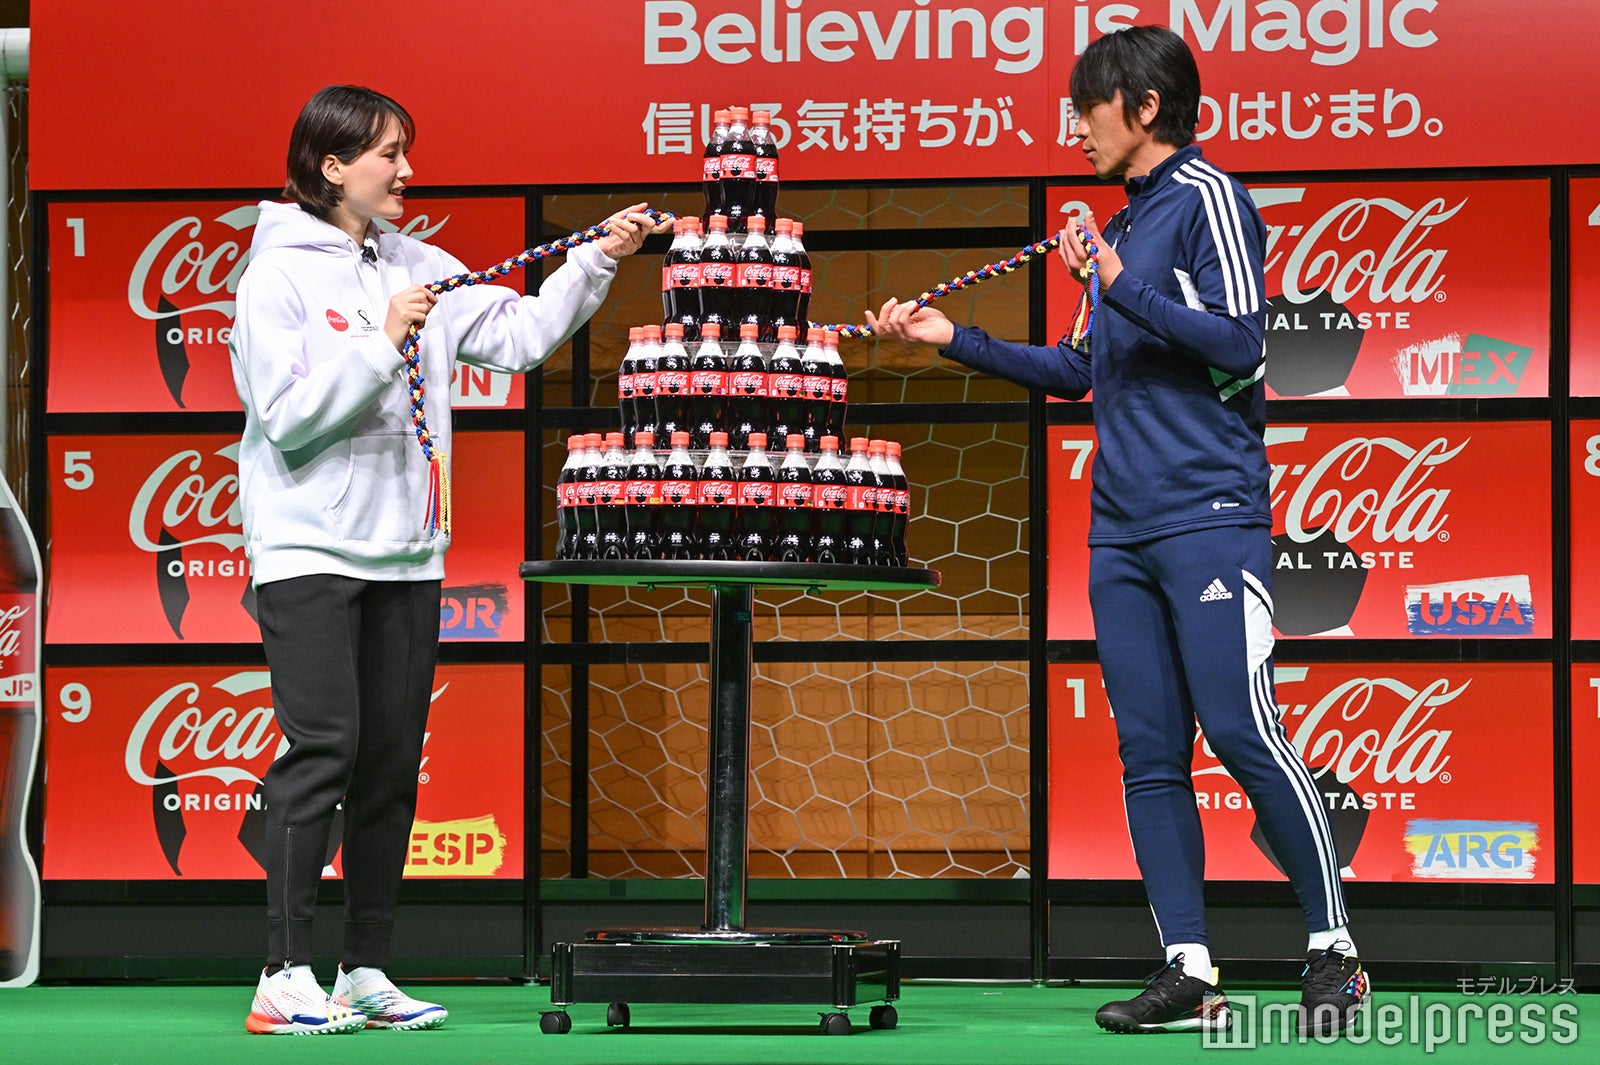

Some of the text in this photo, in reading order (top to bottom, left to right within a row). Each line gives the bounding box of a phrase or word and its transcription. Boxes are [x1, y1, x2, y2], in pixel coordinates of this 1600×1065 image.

[644, 0, 1044, 74] Believing
[1169, 0, 1439, 66] Magic
[721, 156, 750, 170] Coca-Cola
[66, 218, 86, 257] 1
[1249, 188, 1469, 304] -Cola
[703, 264, 733, 277] Coca-Cola
[1319, 312, 1411, 330] TASTE
[166, 328, 231, 345] ORIG
[1409, 351, 1519, 385] MEX
[734, 373, 763, 386] Coca-Cola
[1062, 440, 1094, 480] 7
[64, 451, 95, 490] 5
[626, 482, 656, 495] Coca-Cola
[662, 482, 691, 495] Coca-Cola
[703, 482, 733, 495] Coca-Cola
[743, 483, 772, 496] Coca-Cola
[1263, 427, 1471, 543] -Cola
[167, 560, 244, 577] ORIGI
[1323, 551, 1414, 569] TASTE
[1200, 591, 1233, 602] adidas
[440, 597, 497, 629] OR
[1420, 592, 1525, 625] USA
[60, 682, 92, 723] 9
[163, 794, 267, 811] ORIGIN
[1325, 792, 1416, 811] TASTE
[405, 833, 494, 866] ESP
[1422, 834, 1524, 869] ARG
